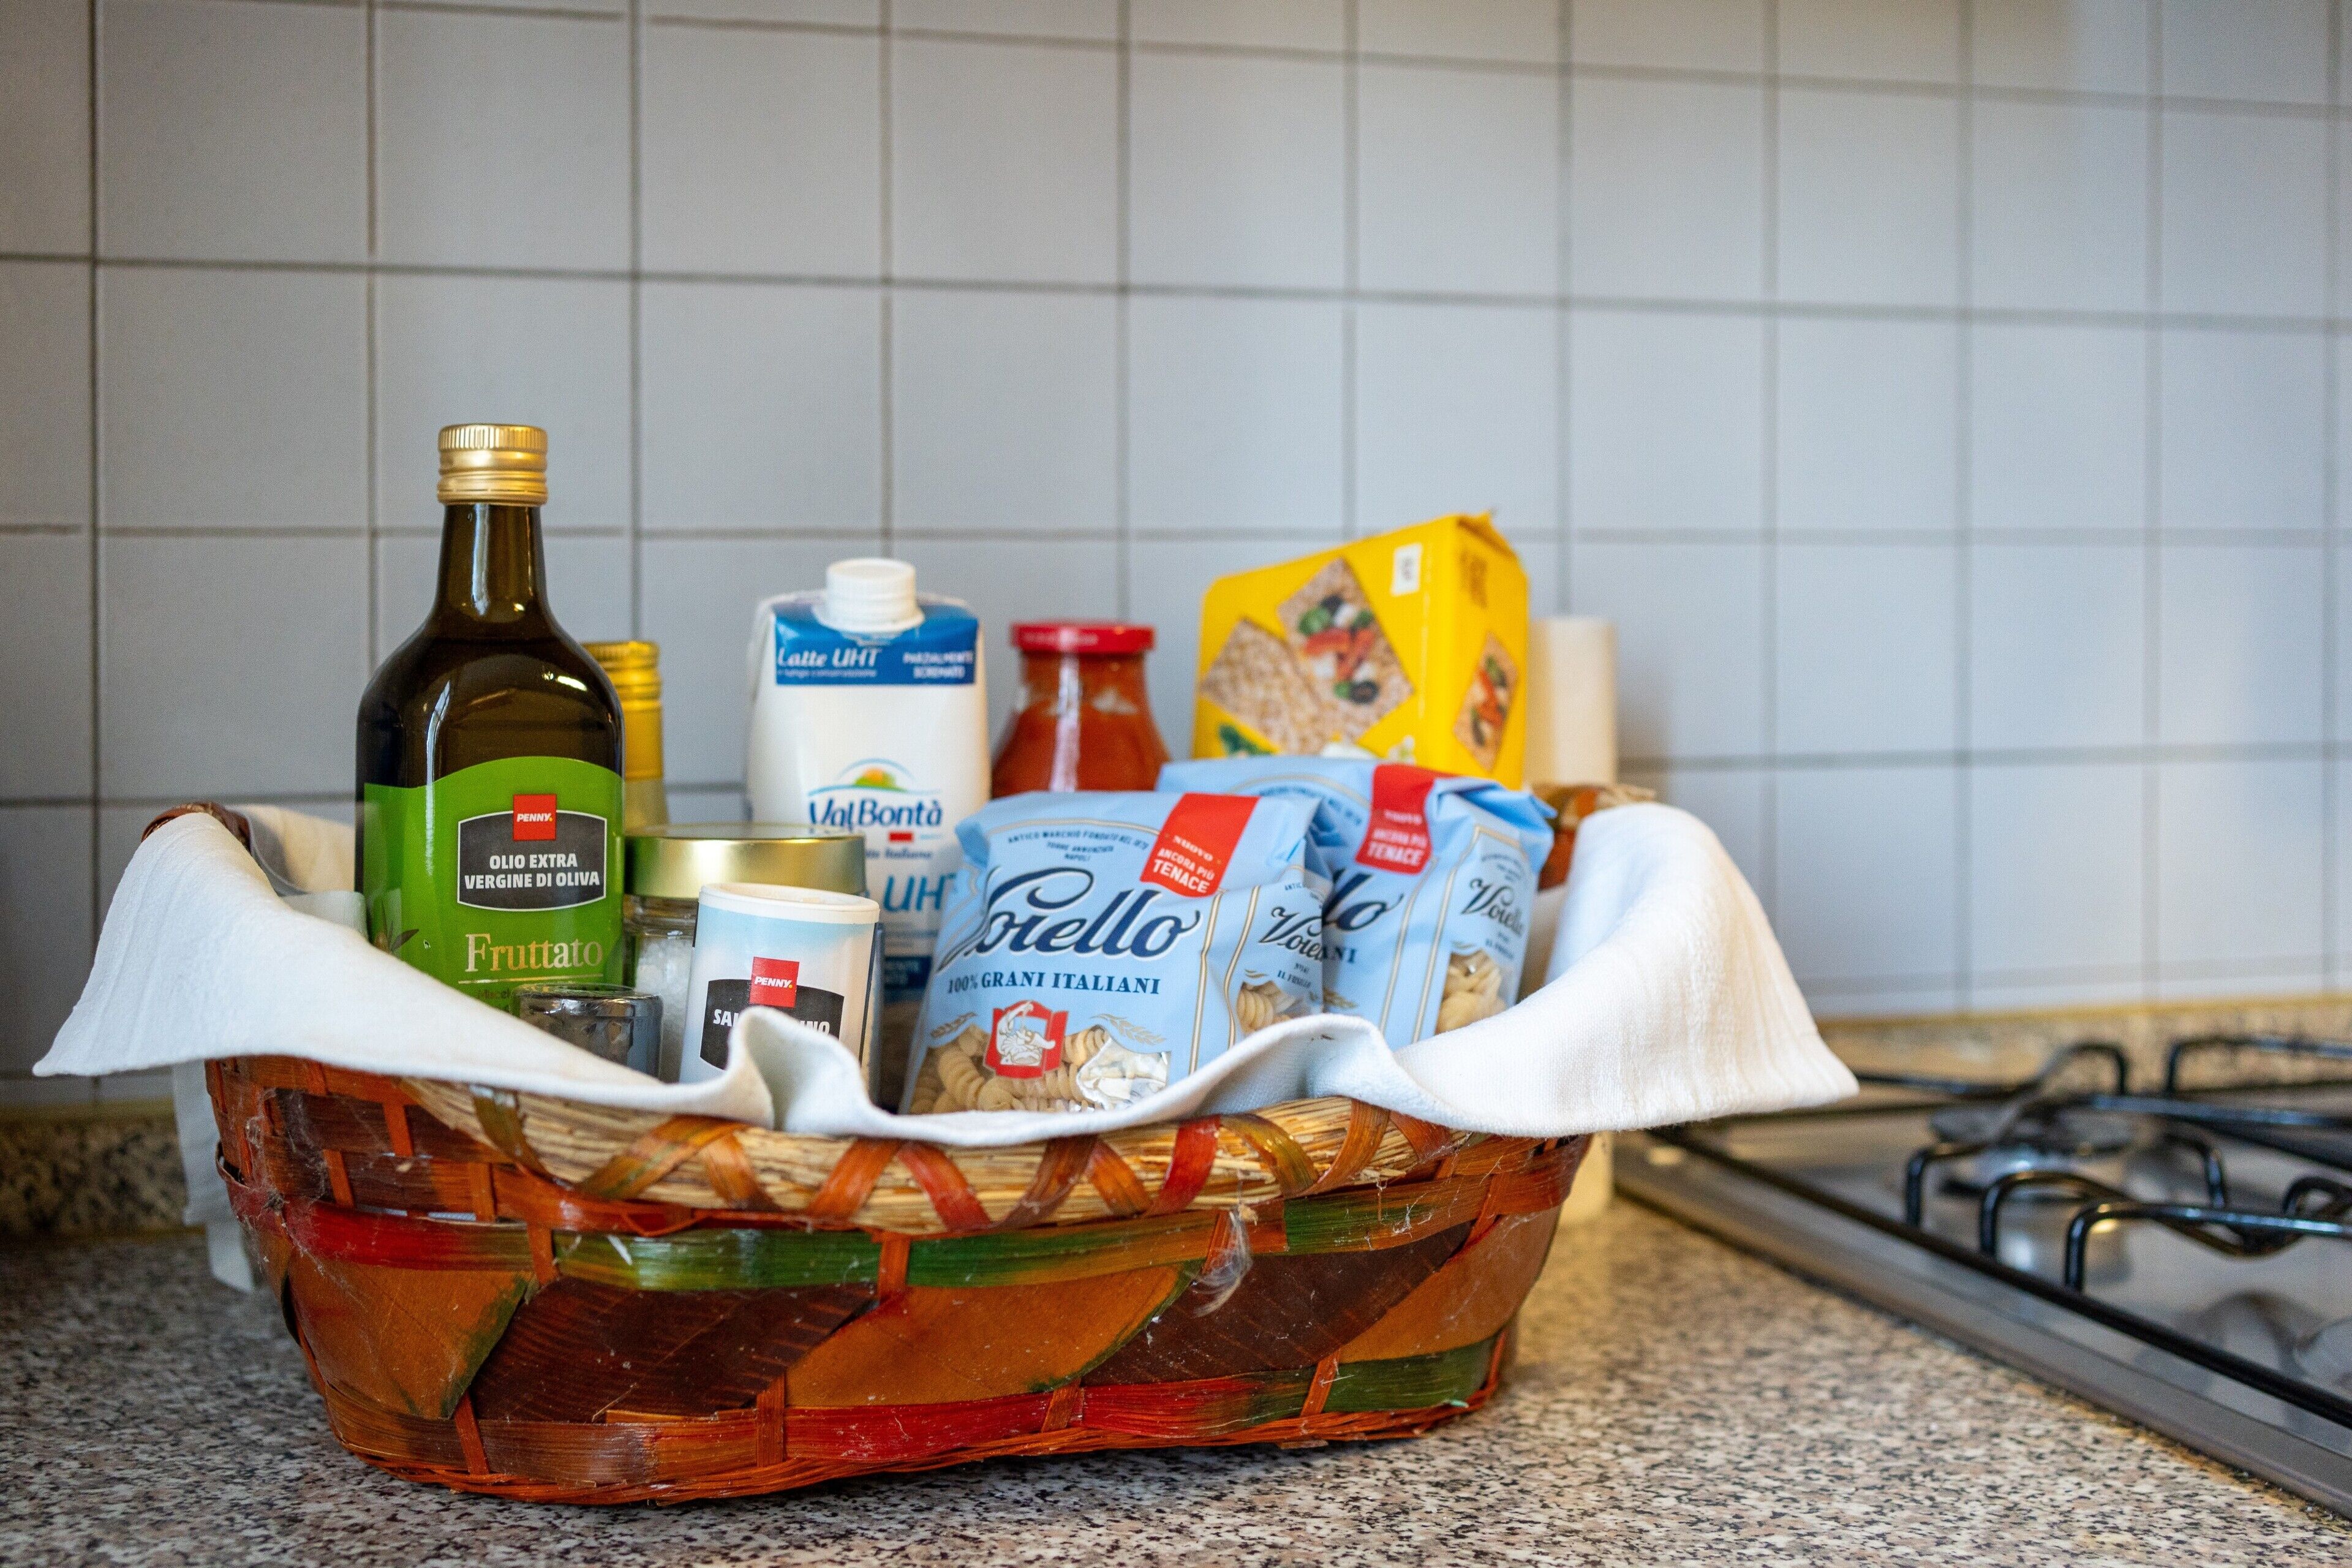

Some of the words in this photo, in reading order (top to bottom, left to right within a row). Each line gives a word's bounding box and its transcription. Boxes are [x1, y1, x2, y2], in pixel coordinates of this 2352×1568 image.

[778, 647, 827, 668] Latte
[832, 647, 882, 668] UHT
[489, 854, 526, 870] OLIO
[530, 853, 578, 869] EXTRA
[1157, 848, 1196, 872] ANCORA
[464, 873, 532, 889] VERGINE
[537, 873, 552, 888] DI
[556, 871, 600, 888] OLIVA
[1152, 858, 1211, 894] TENACE
[465, 933, 603, 973] Fruttato
[948, 974, 979, 994] 100%
[981, 971, 1045, 988] GRANI
[1051, 972, 1161, 995] ITALIANI
